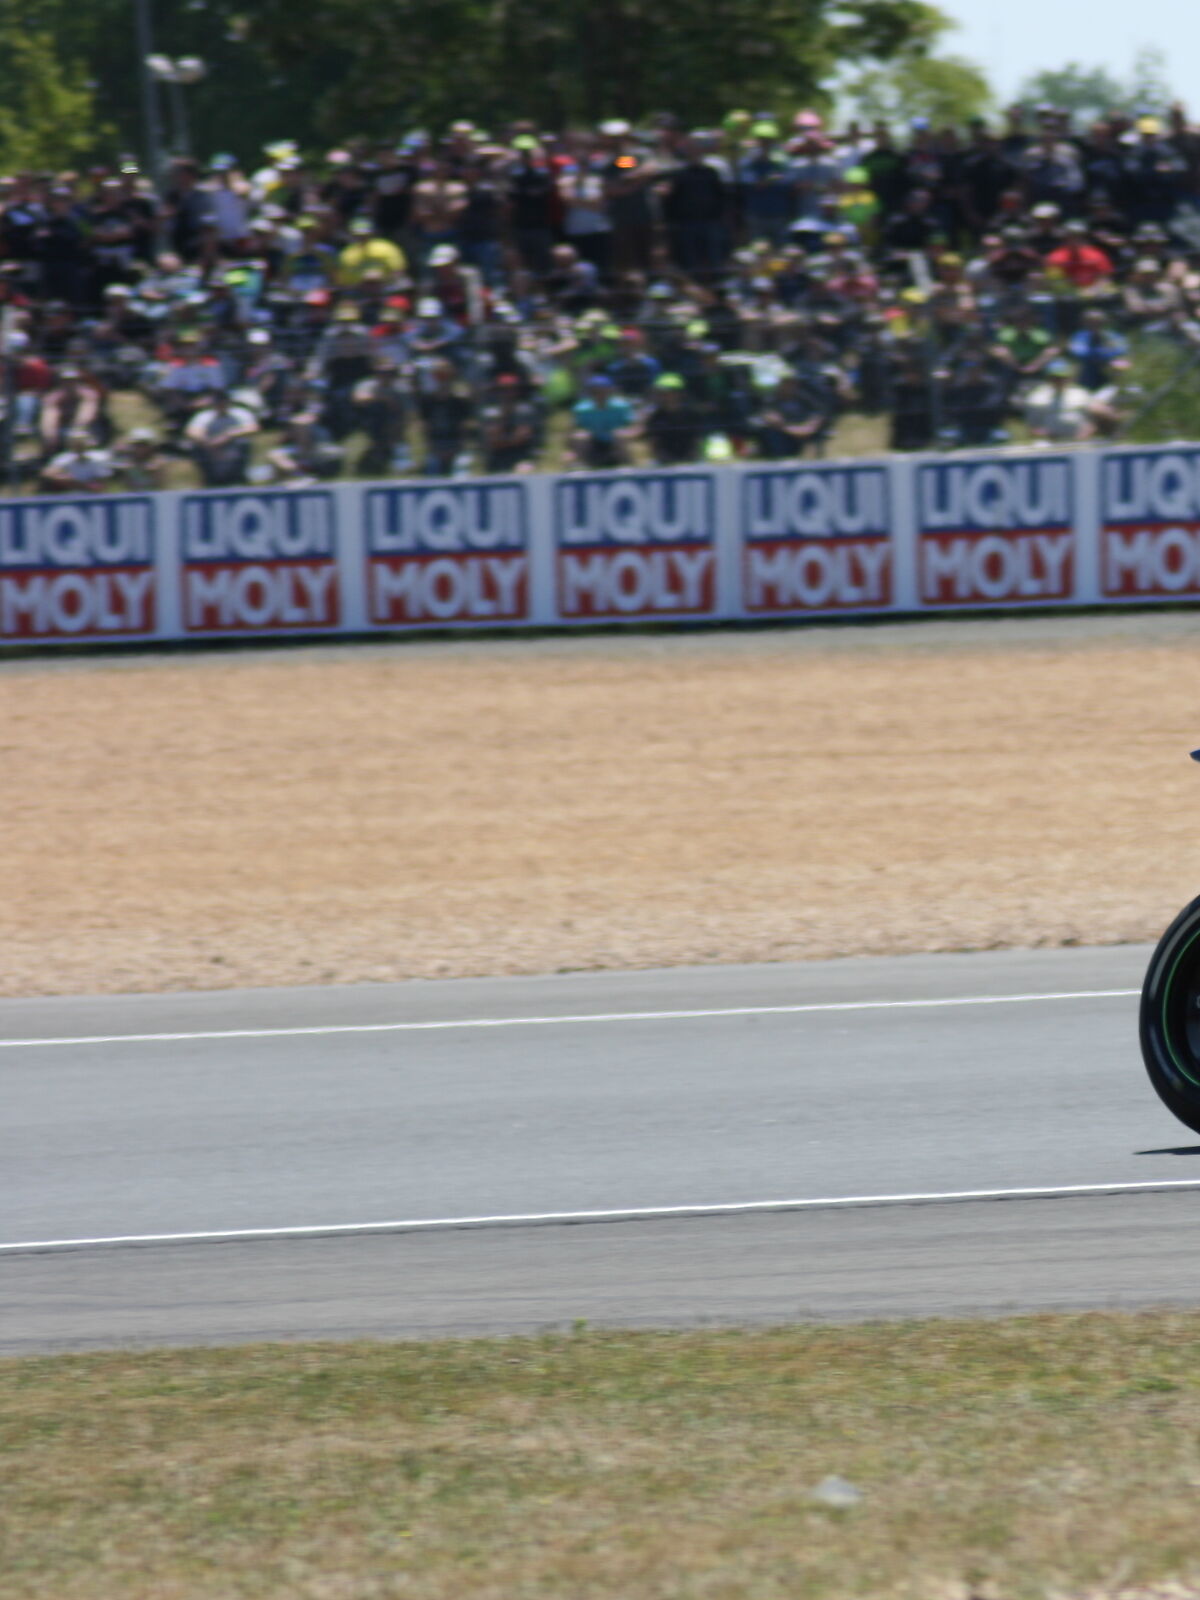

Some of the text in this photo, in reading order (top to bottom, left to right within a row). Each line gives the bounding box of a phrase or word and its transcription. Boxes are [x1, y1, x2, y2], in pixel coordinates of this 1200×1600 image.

[187, 495, 331, 558] LIQUI
[371, 487, 521, 549] LIQUI
[562, 479, 707, 544] LIQUI
[750, 471, 886, 536] LIQUI
[923, 463, 1069, 527] LIQUI
[0, 502, 150, 566] LIQUI
[188, 565, 336, 626] MOLY
[372, 557, 527, 619] MOLY
[562, 550, 714, 613] MOLY
[750, 541, 890, 605] MOLY
[922, 534, 1072, 599] MOLY
[0, 571, 153, 634] MOLY
